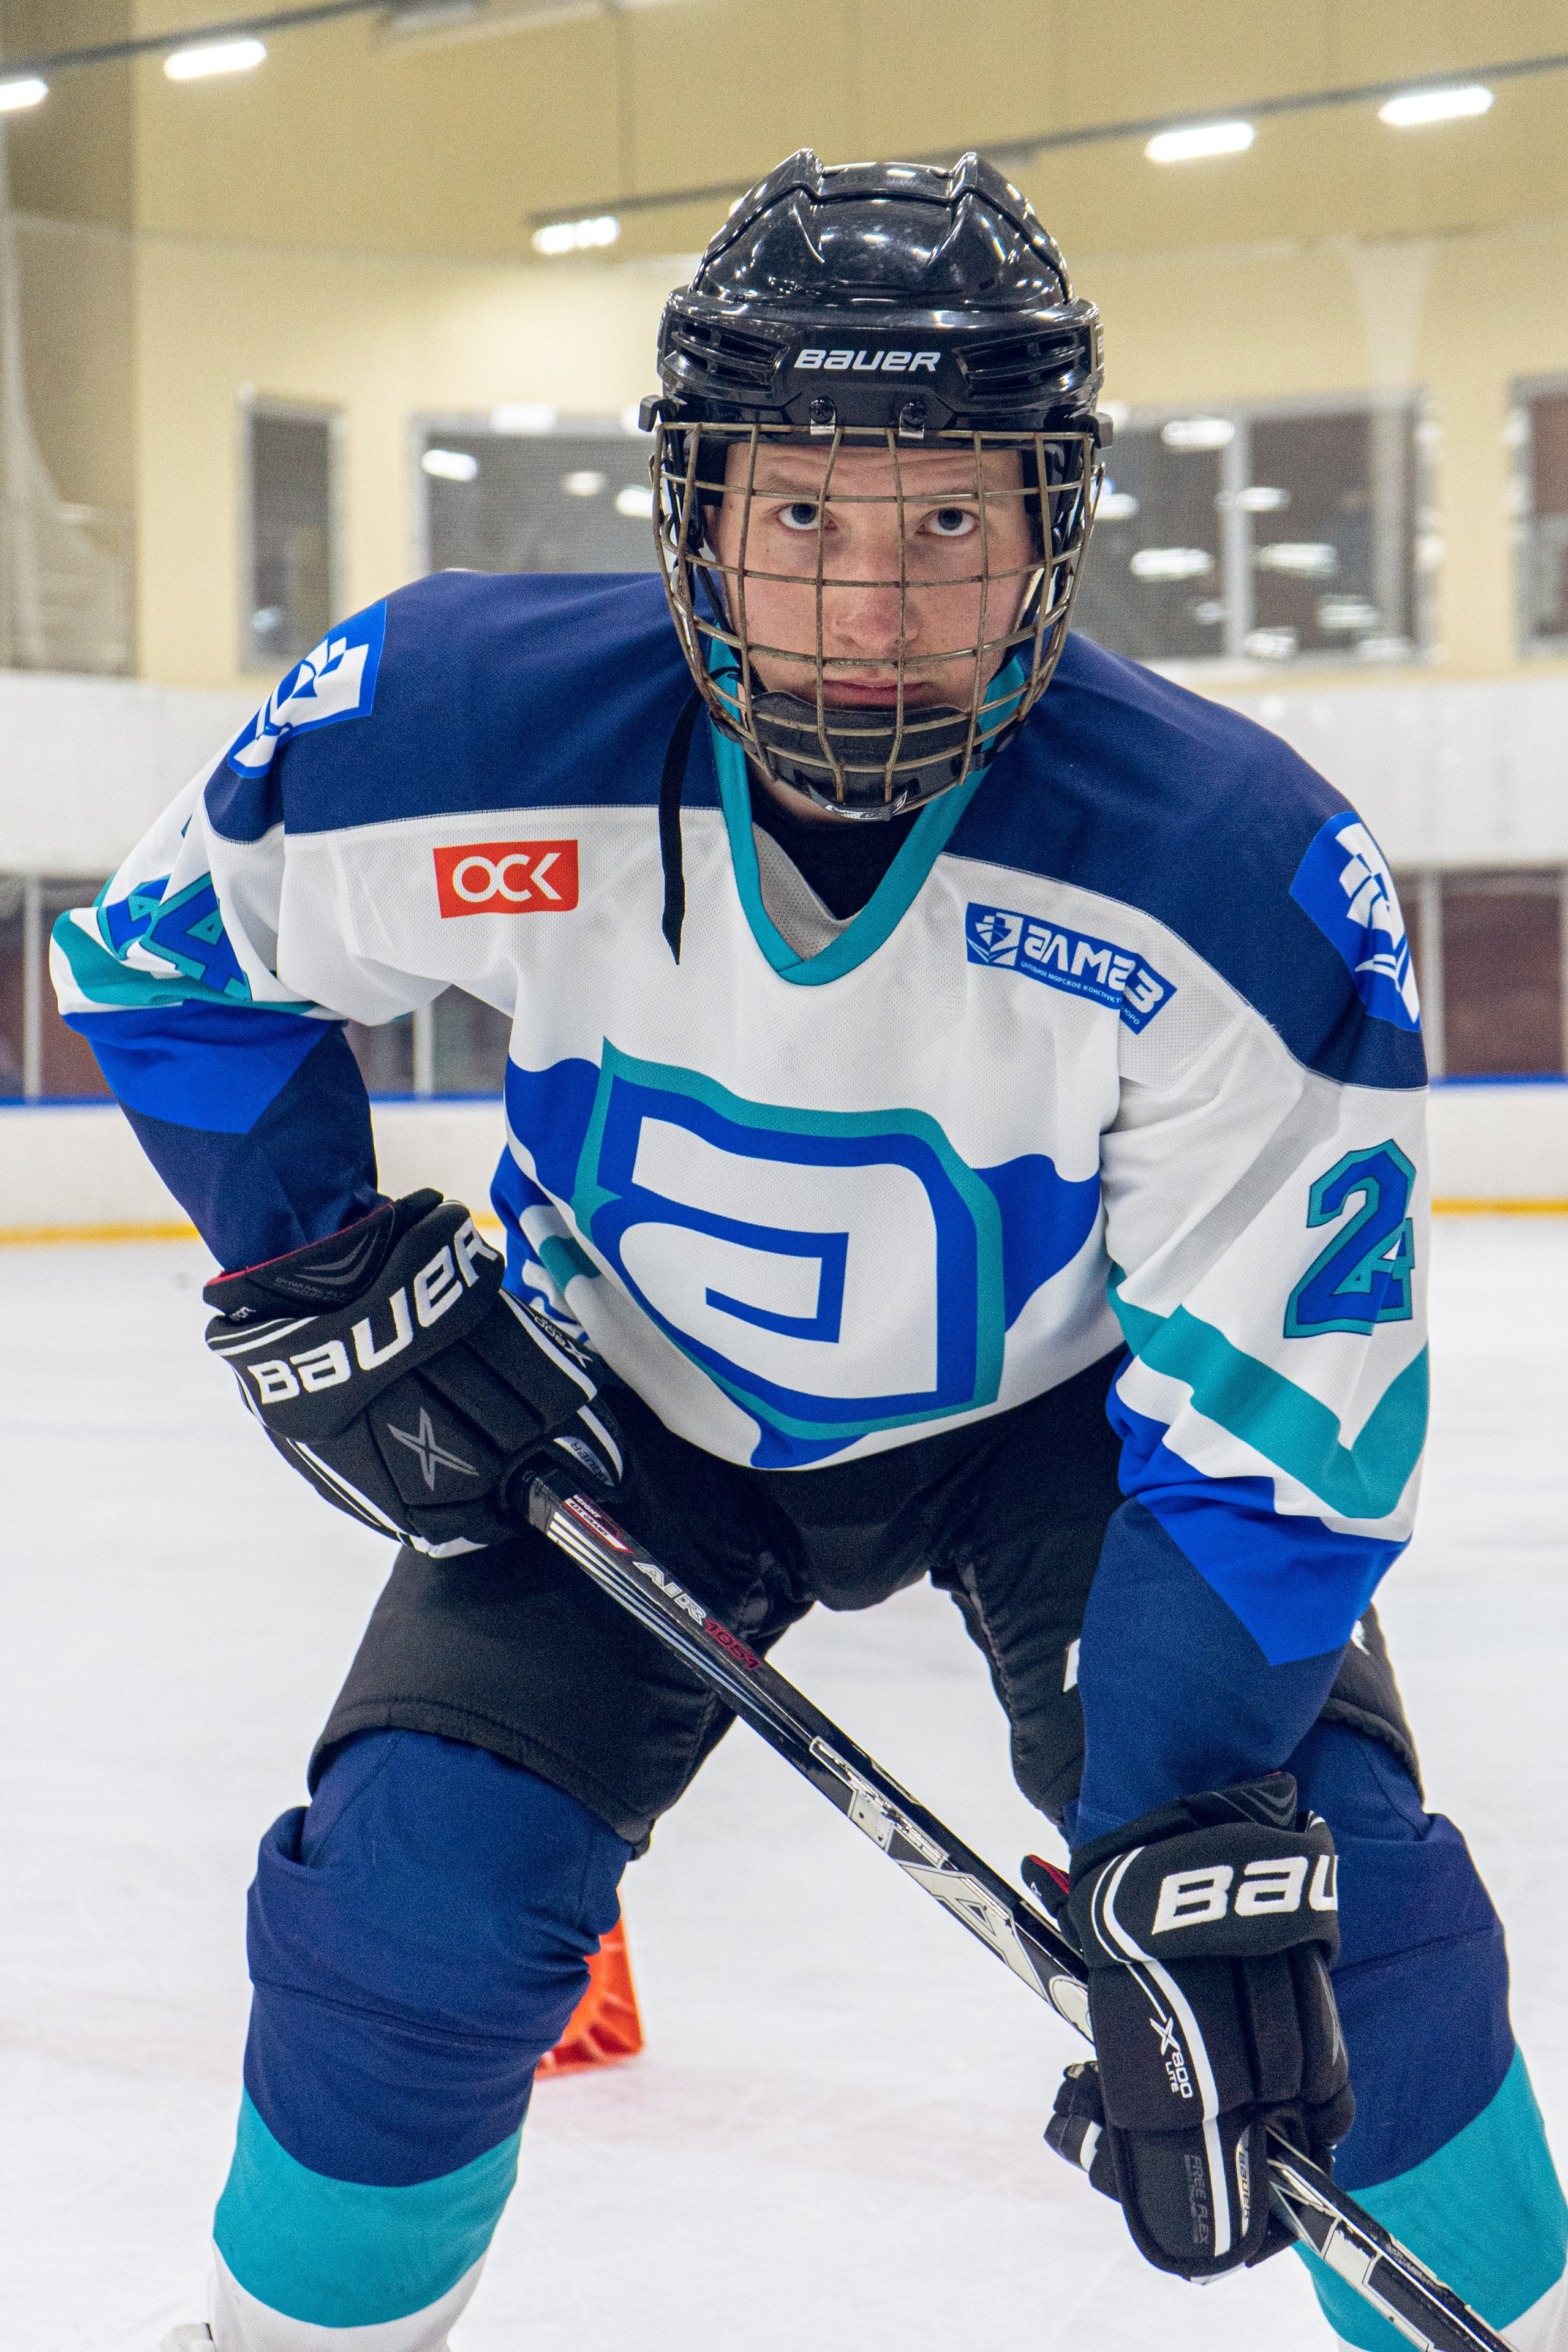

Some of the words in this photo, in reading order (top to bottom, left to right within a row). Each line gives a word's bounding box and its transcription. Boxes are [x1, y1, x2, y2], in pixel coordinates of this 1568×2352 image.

[794, 349, 941, 372] BAUER
[1047, 973, 1082, 989] МОРСКОЕ
[1083, 984, 1123, 1003] КОНСТРУКТ
[247, 1216, 500, 1404] BAUER
[633, 1561, 707, 1626] AIR
